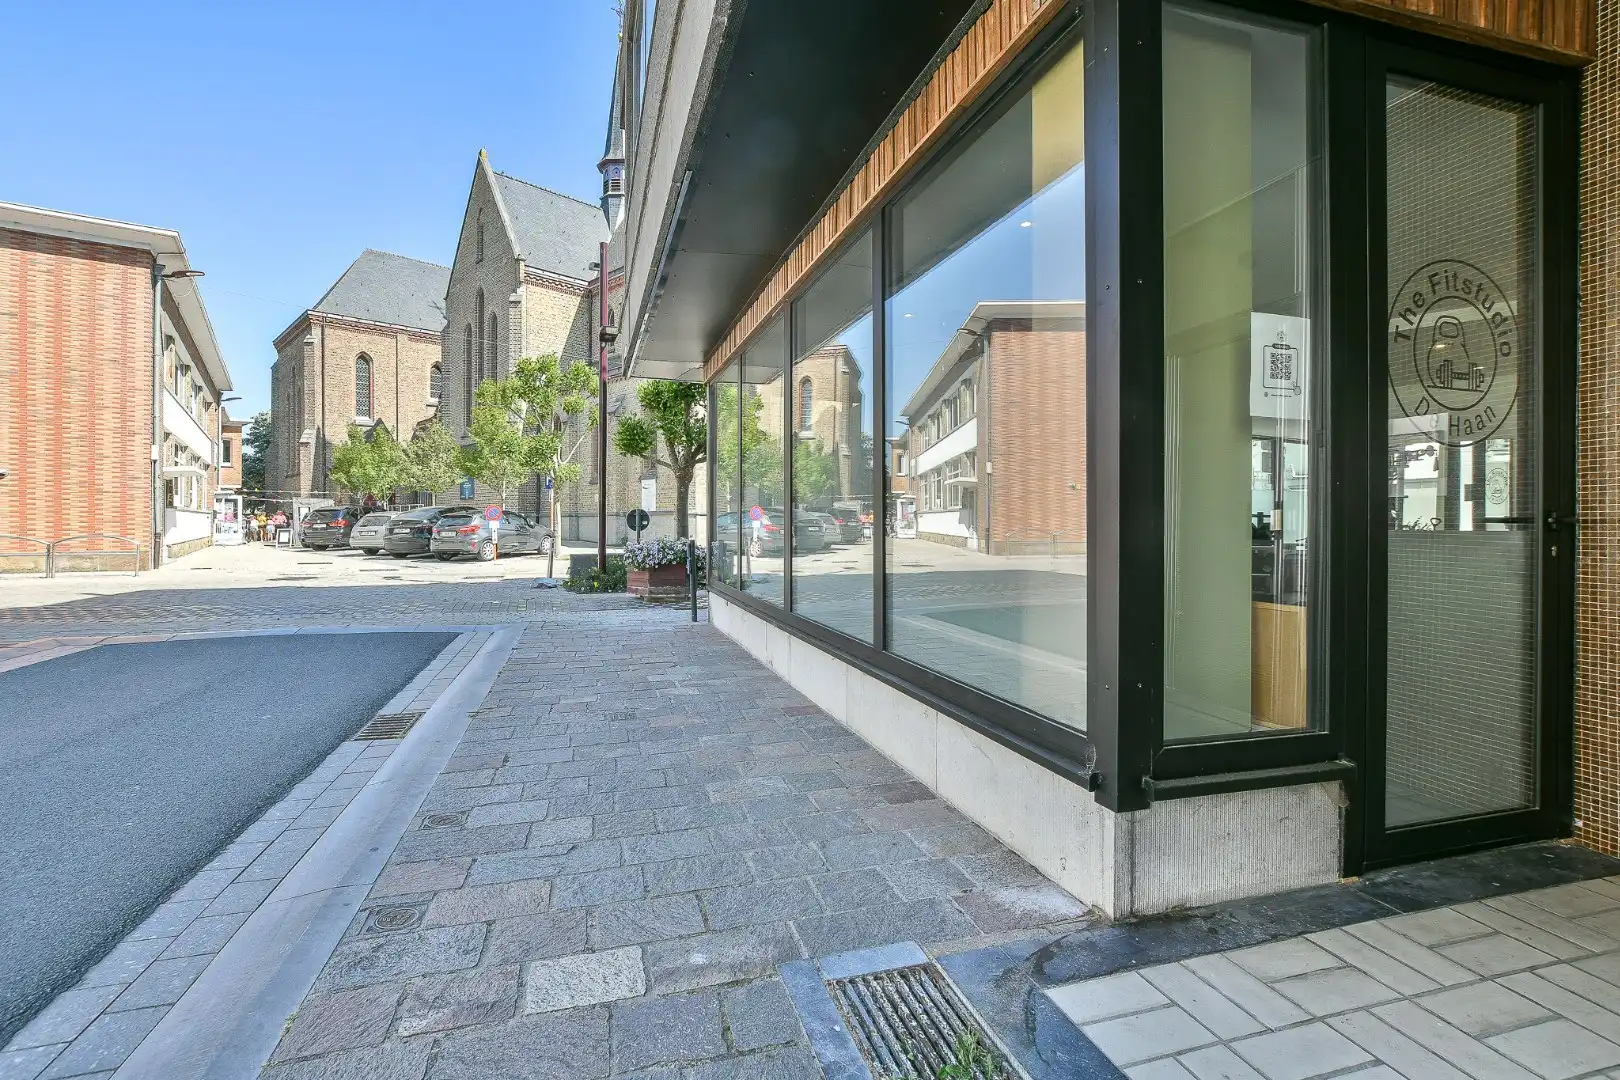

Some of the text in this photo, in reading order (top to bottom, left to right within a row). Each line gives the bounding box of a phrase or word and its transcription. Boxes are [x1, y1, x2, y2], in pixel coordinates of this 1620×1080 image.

[1394, 269, 1513, 357] The Fitstudio
[1449, 405, 1497, 436] Haan
